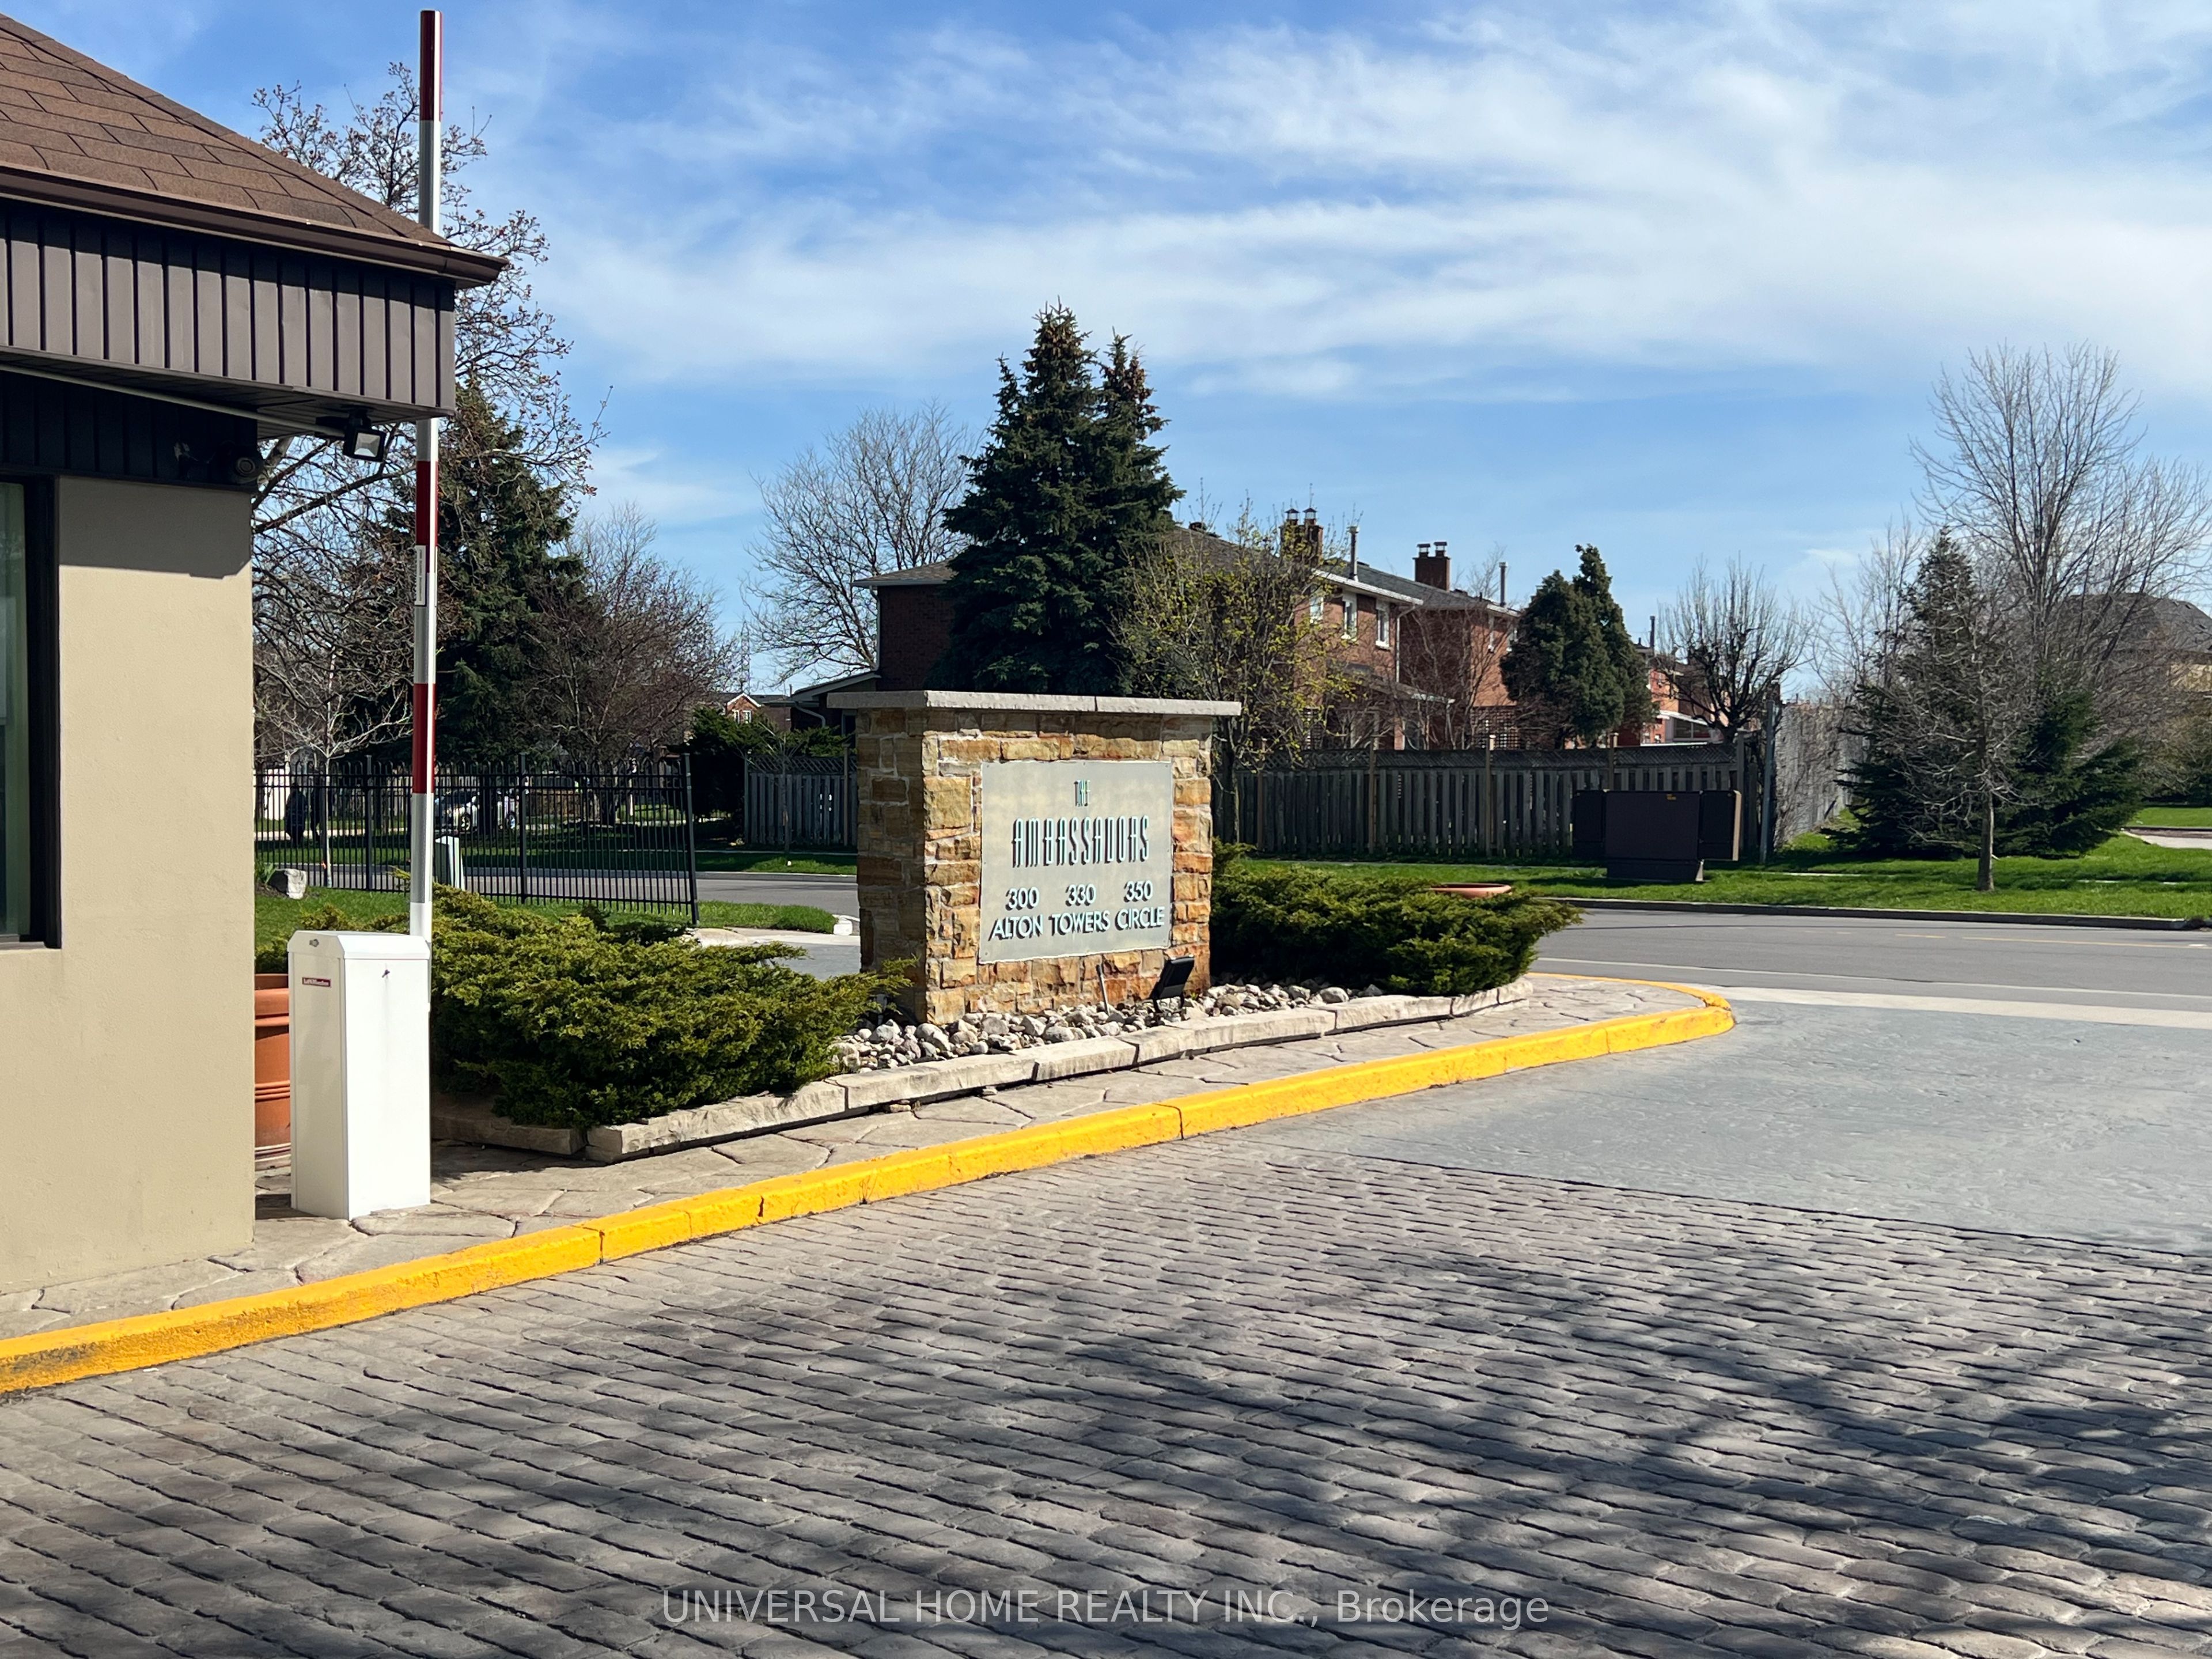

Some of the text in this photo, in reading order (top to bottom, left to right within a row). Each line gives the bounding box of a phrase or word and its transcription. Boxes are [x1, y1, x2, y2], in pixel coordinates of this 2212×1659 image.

[1013, 816, 1149, 868] AMBASSADORS
[1006, 880, 1153, 910] 300 330 350
[989, 906, 1165, 940] ALTON TOWERS CIRCLE
